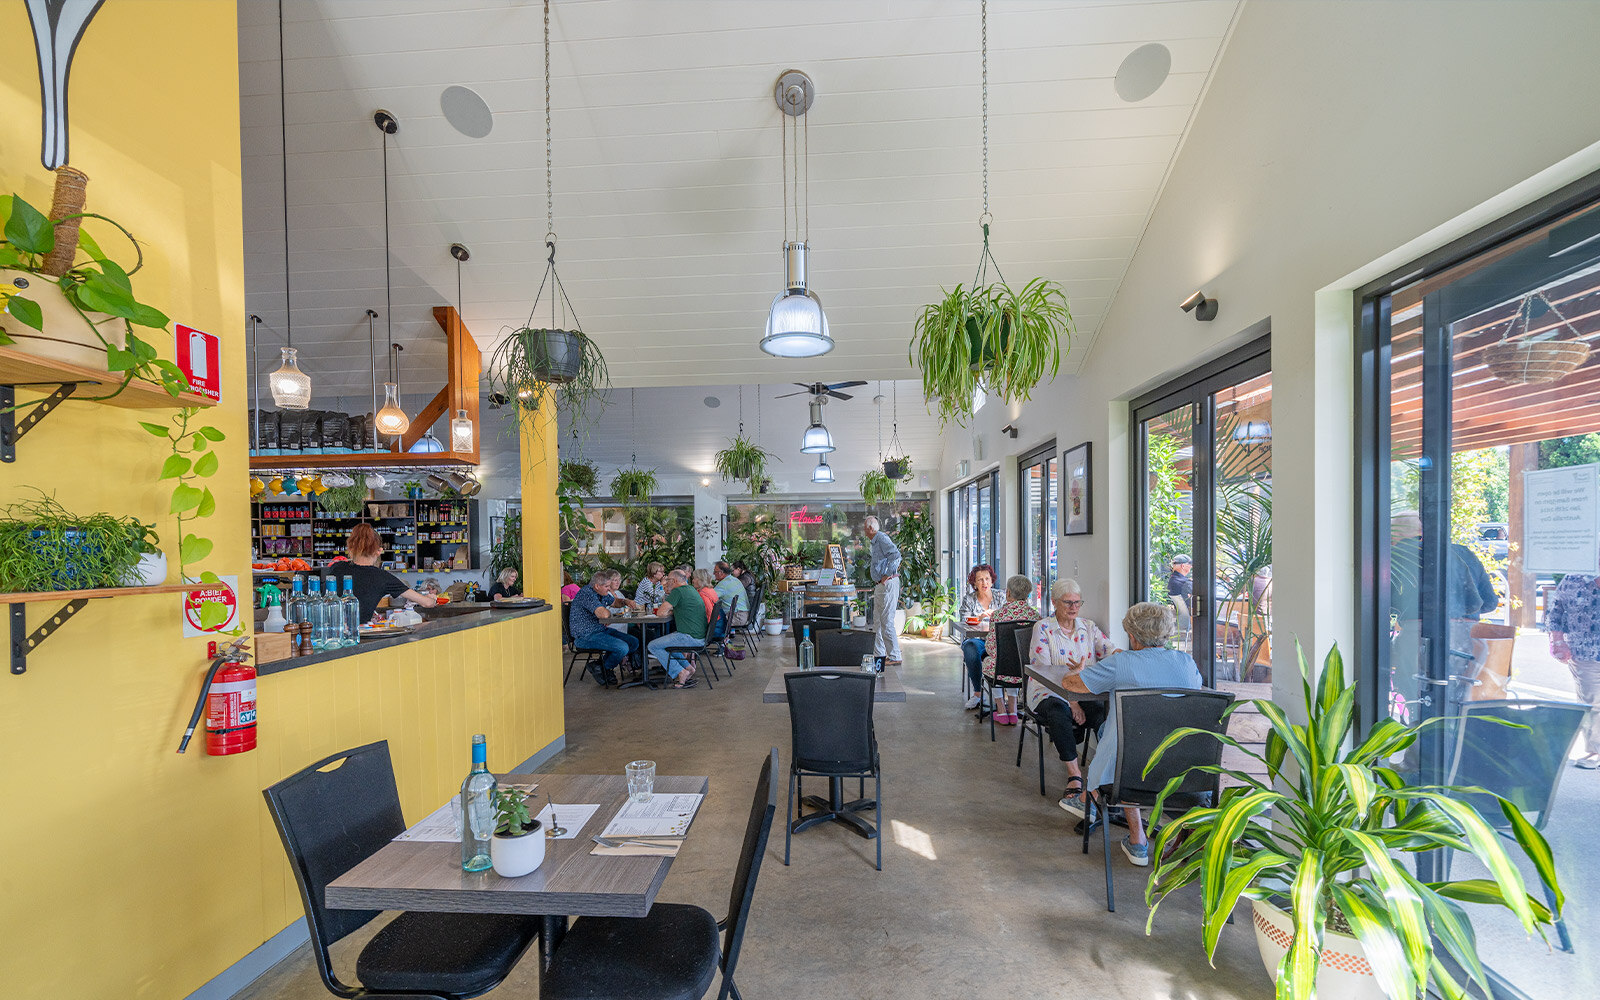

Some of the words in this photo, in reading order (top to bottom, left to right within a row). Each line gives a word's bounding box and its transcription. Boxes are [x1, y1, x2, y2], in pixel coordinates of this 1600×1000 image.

[192, 378, 206, 388] FIRE
[194, 596, 227, 606] POWDER
[875, 658, 882, 671] 6
